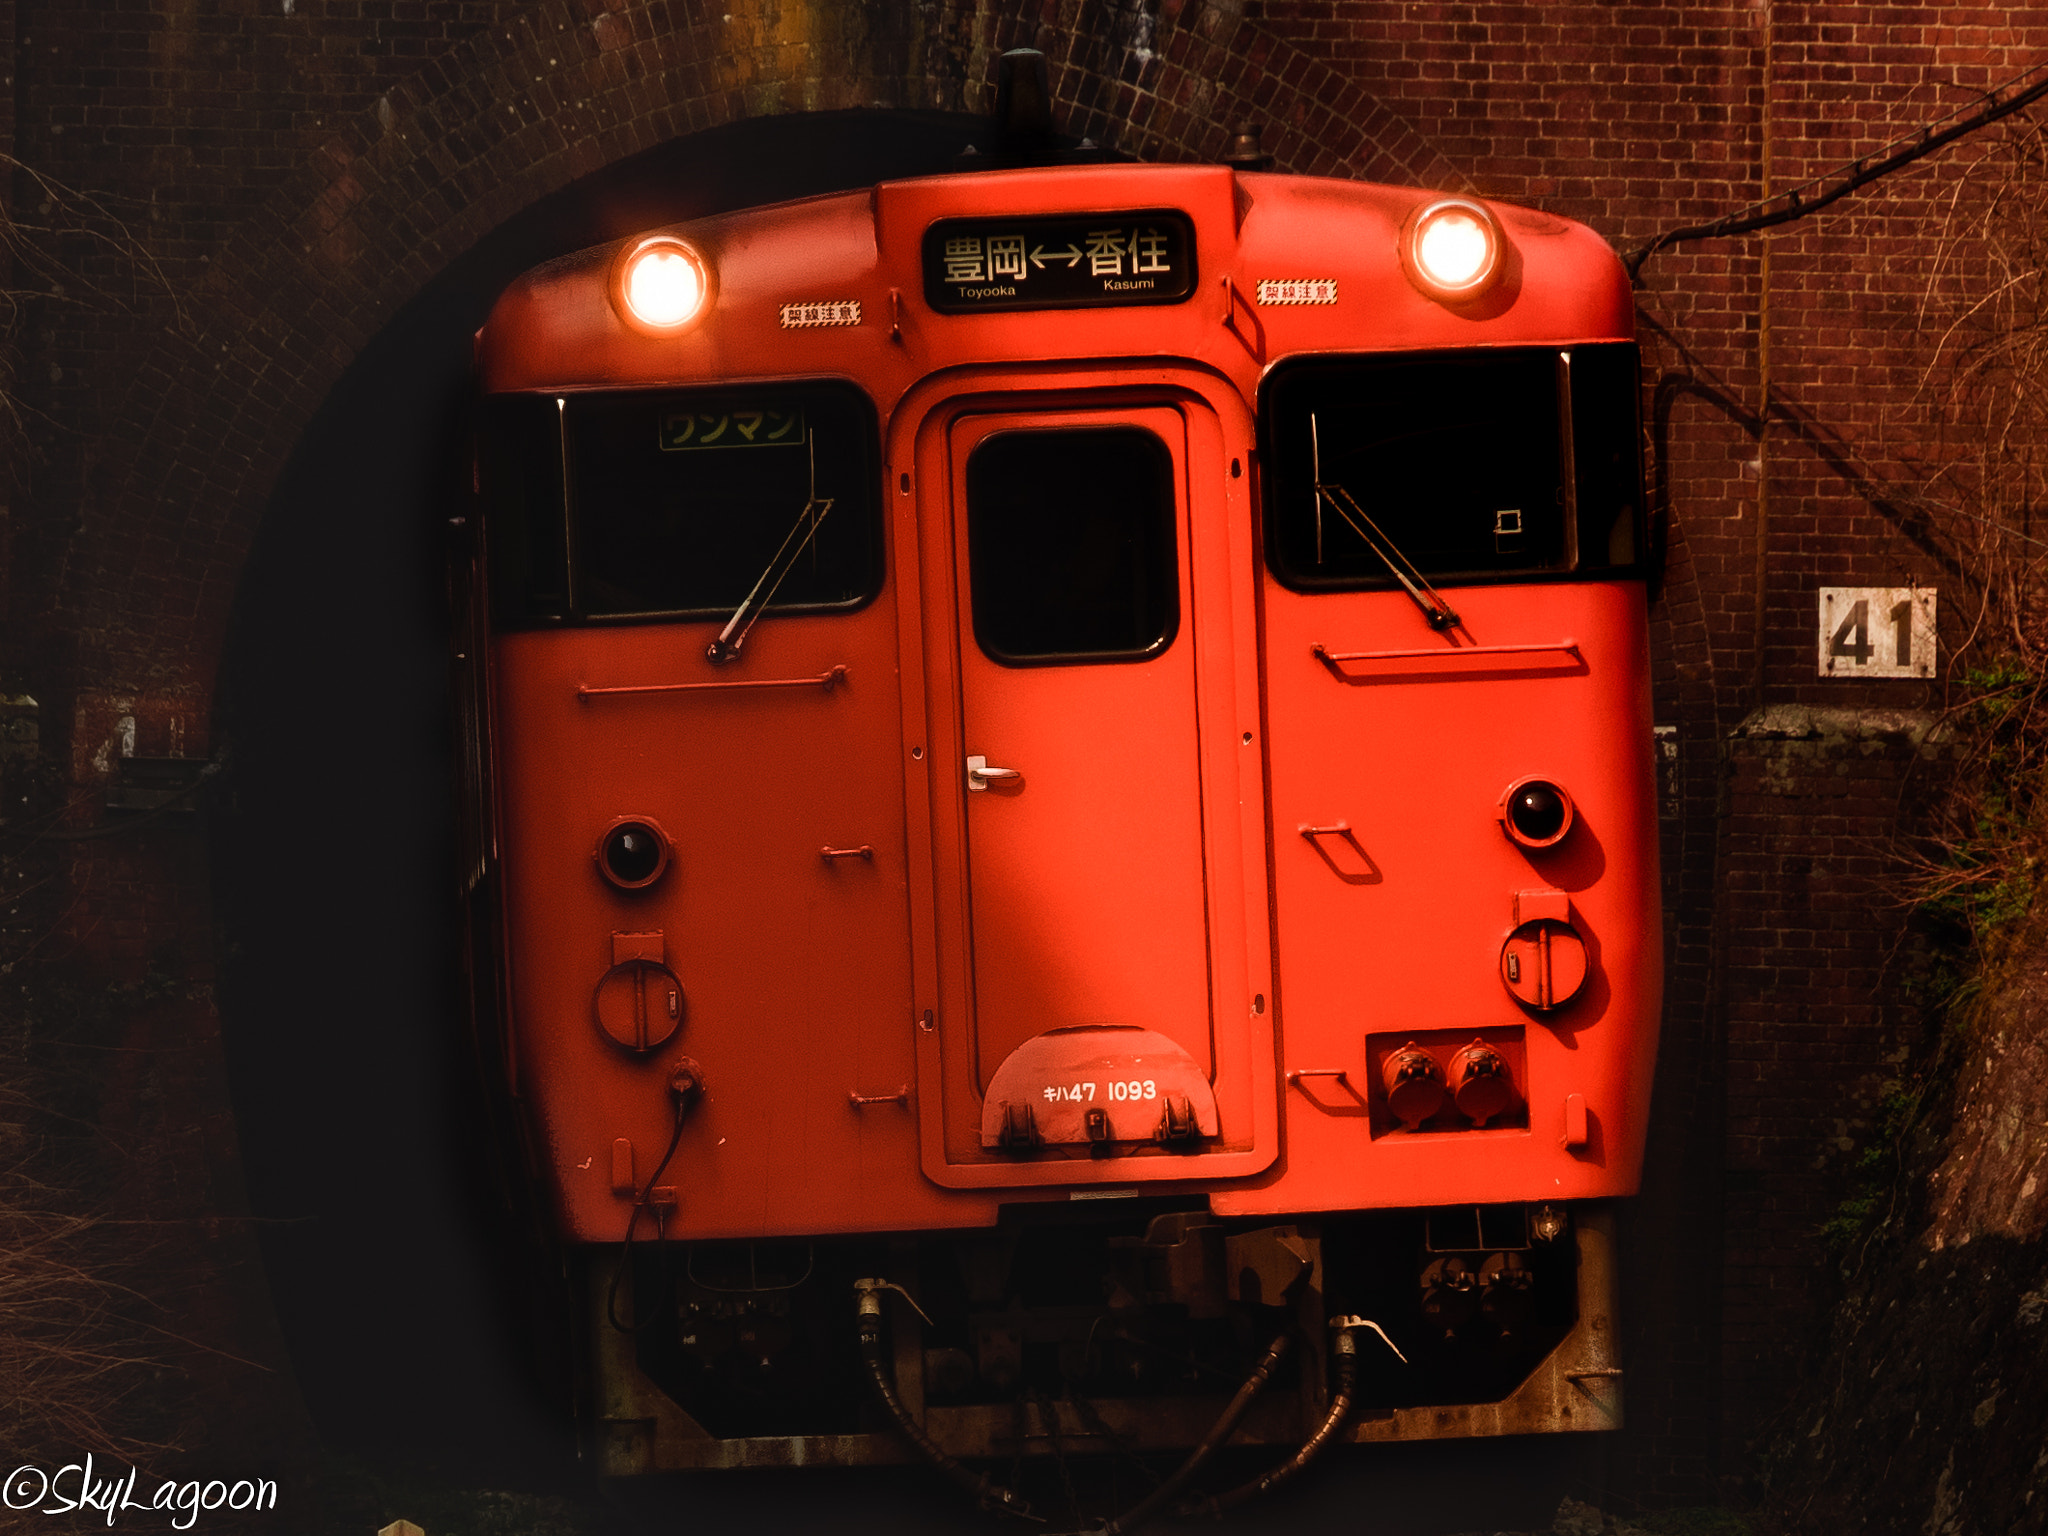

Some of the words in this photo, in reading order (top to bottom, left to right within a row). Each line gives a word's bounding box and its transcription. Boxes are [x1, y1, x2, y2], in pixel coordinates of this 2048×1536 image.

[944, 235, 1027, 282] 豊岡
[1085, 228, 1171, 276] 香住
[957, 286, 1016, 299] Toyooka
[1104, 277, 1155, 291] Kasumi
[667, 411, 795, 444] ワンマン
[1830, 599, 1912, 667] 41
[1043, 1082, 1096, 1102] キハ47
[1108, 1079, 1156, 1101] 1093
